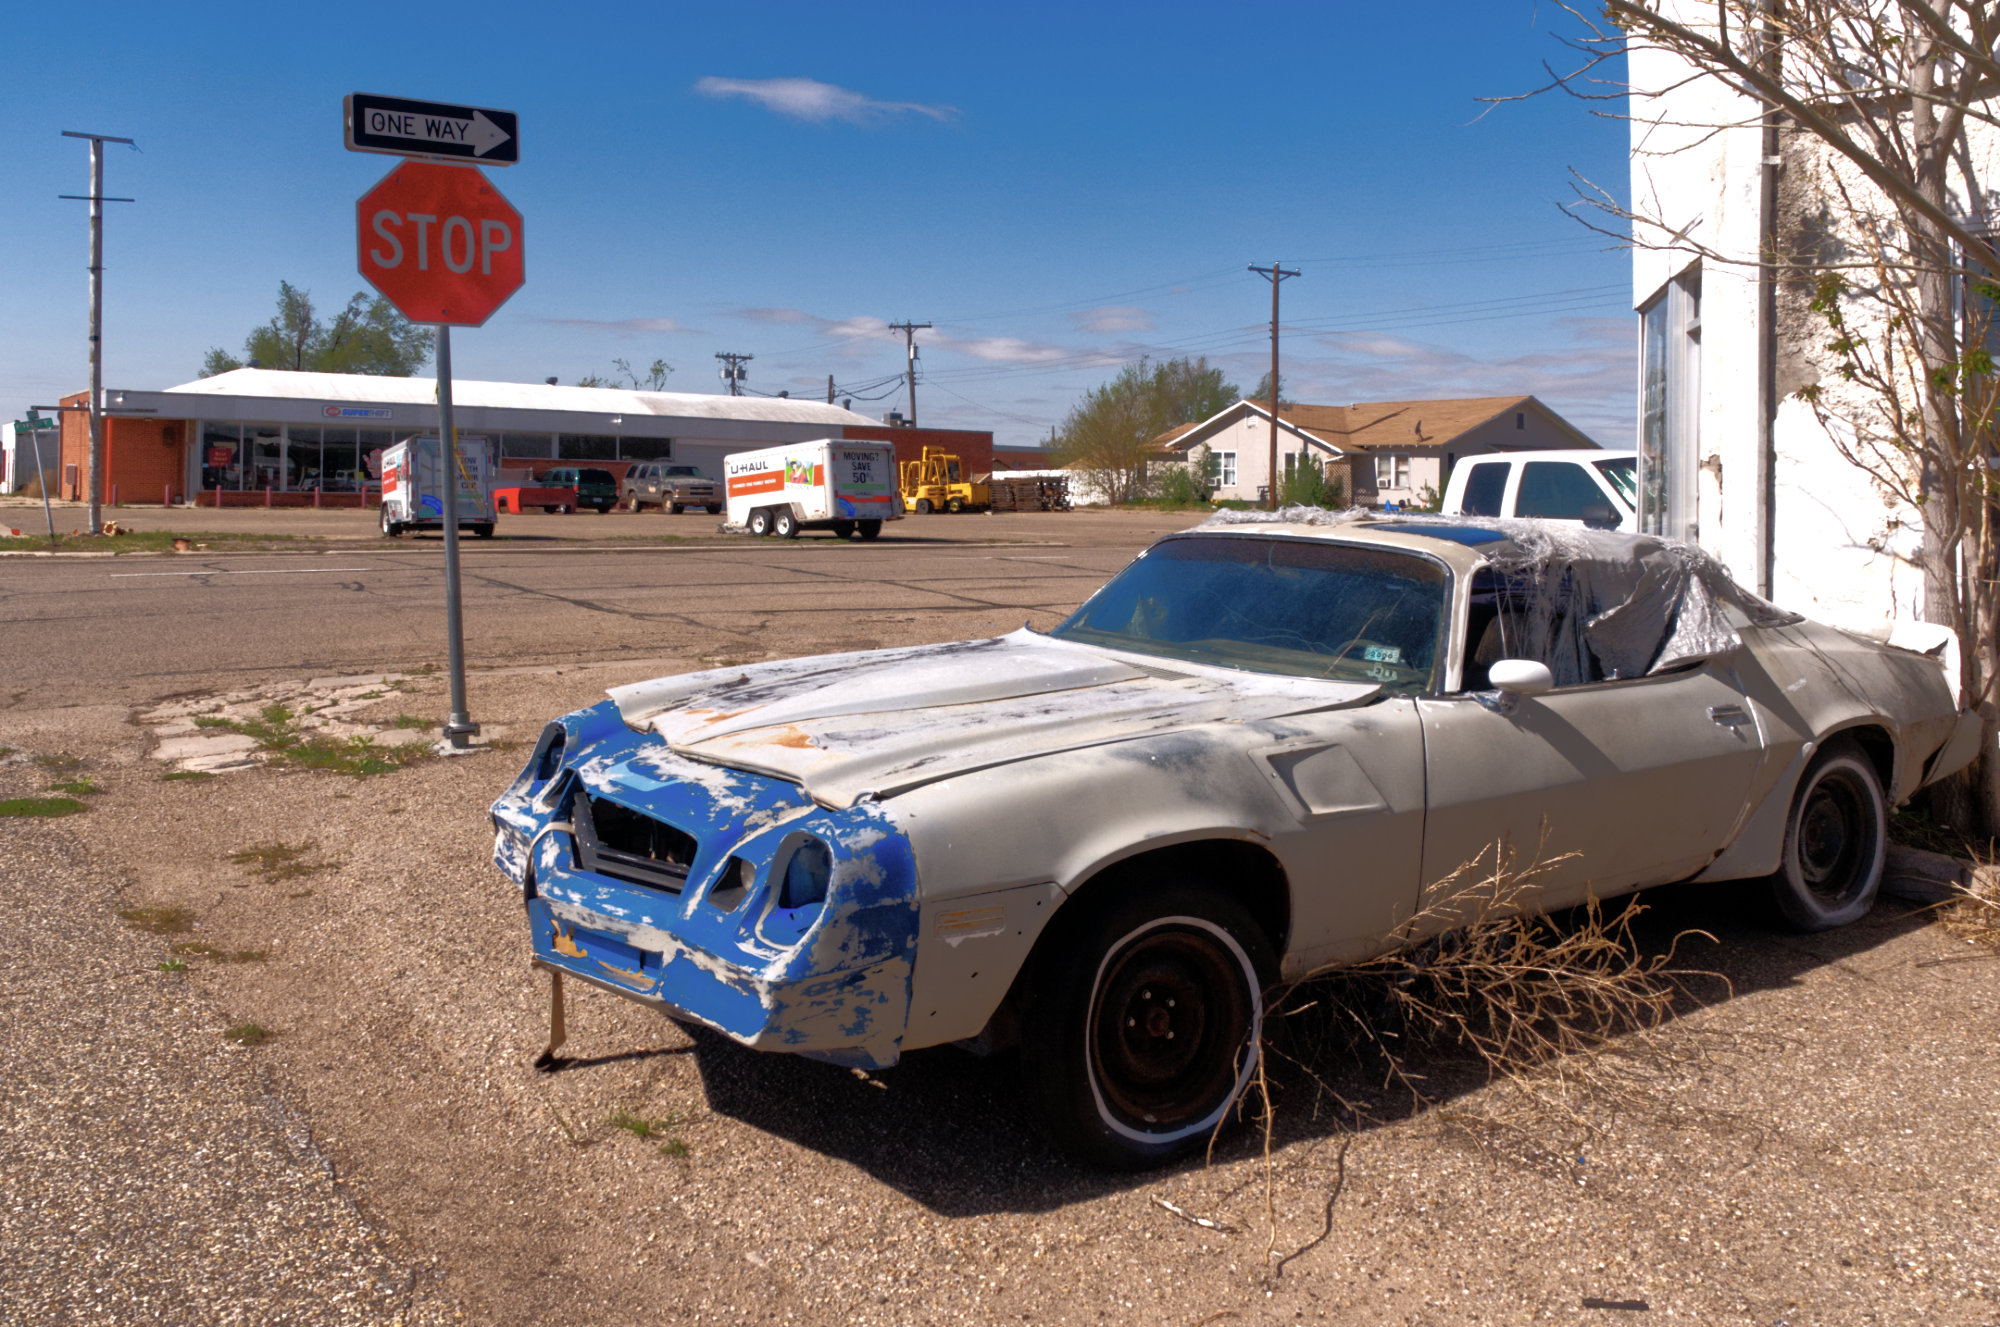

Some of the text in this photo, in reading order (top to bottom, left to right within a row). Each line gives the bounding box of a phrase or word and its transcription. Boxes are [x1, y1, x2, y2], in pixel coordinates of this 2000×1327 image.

[371, 112, 470, 141] ONE WAY
[370, 209, 512, 275] STOP
[843, 451, 879, 462] MOVING?
[731, 461, 768, 474] U-HAUL
[851, 462, 872, 471] SAVE
